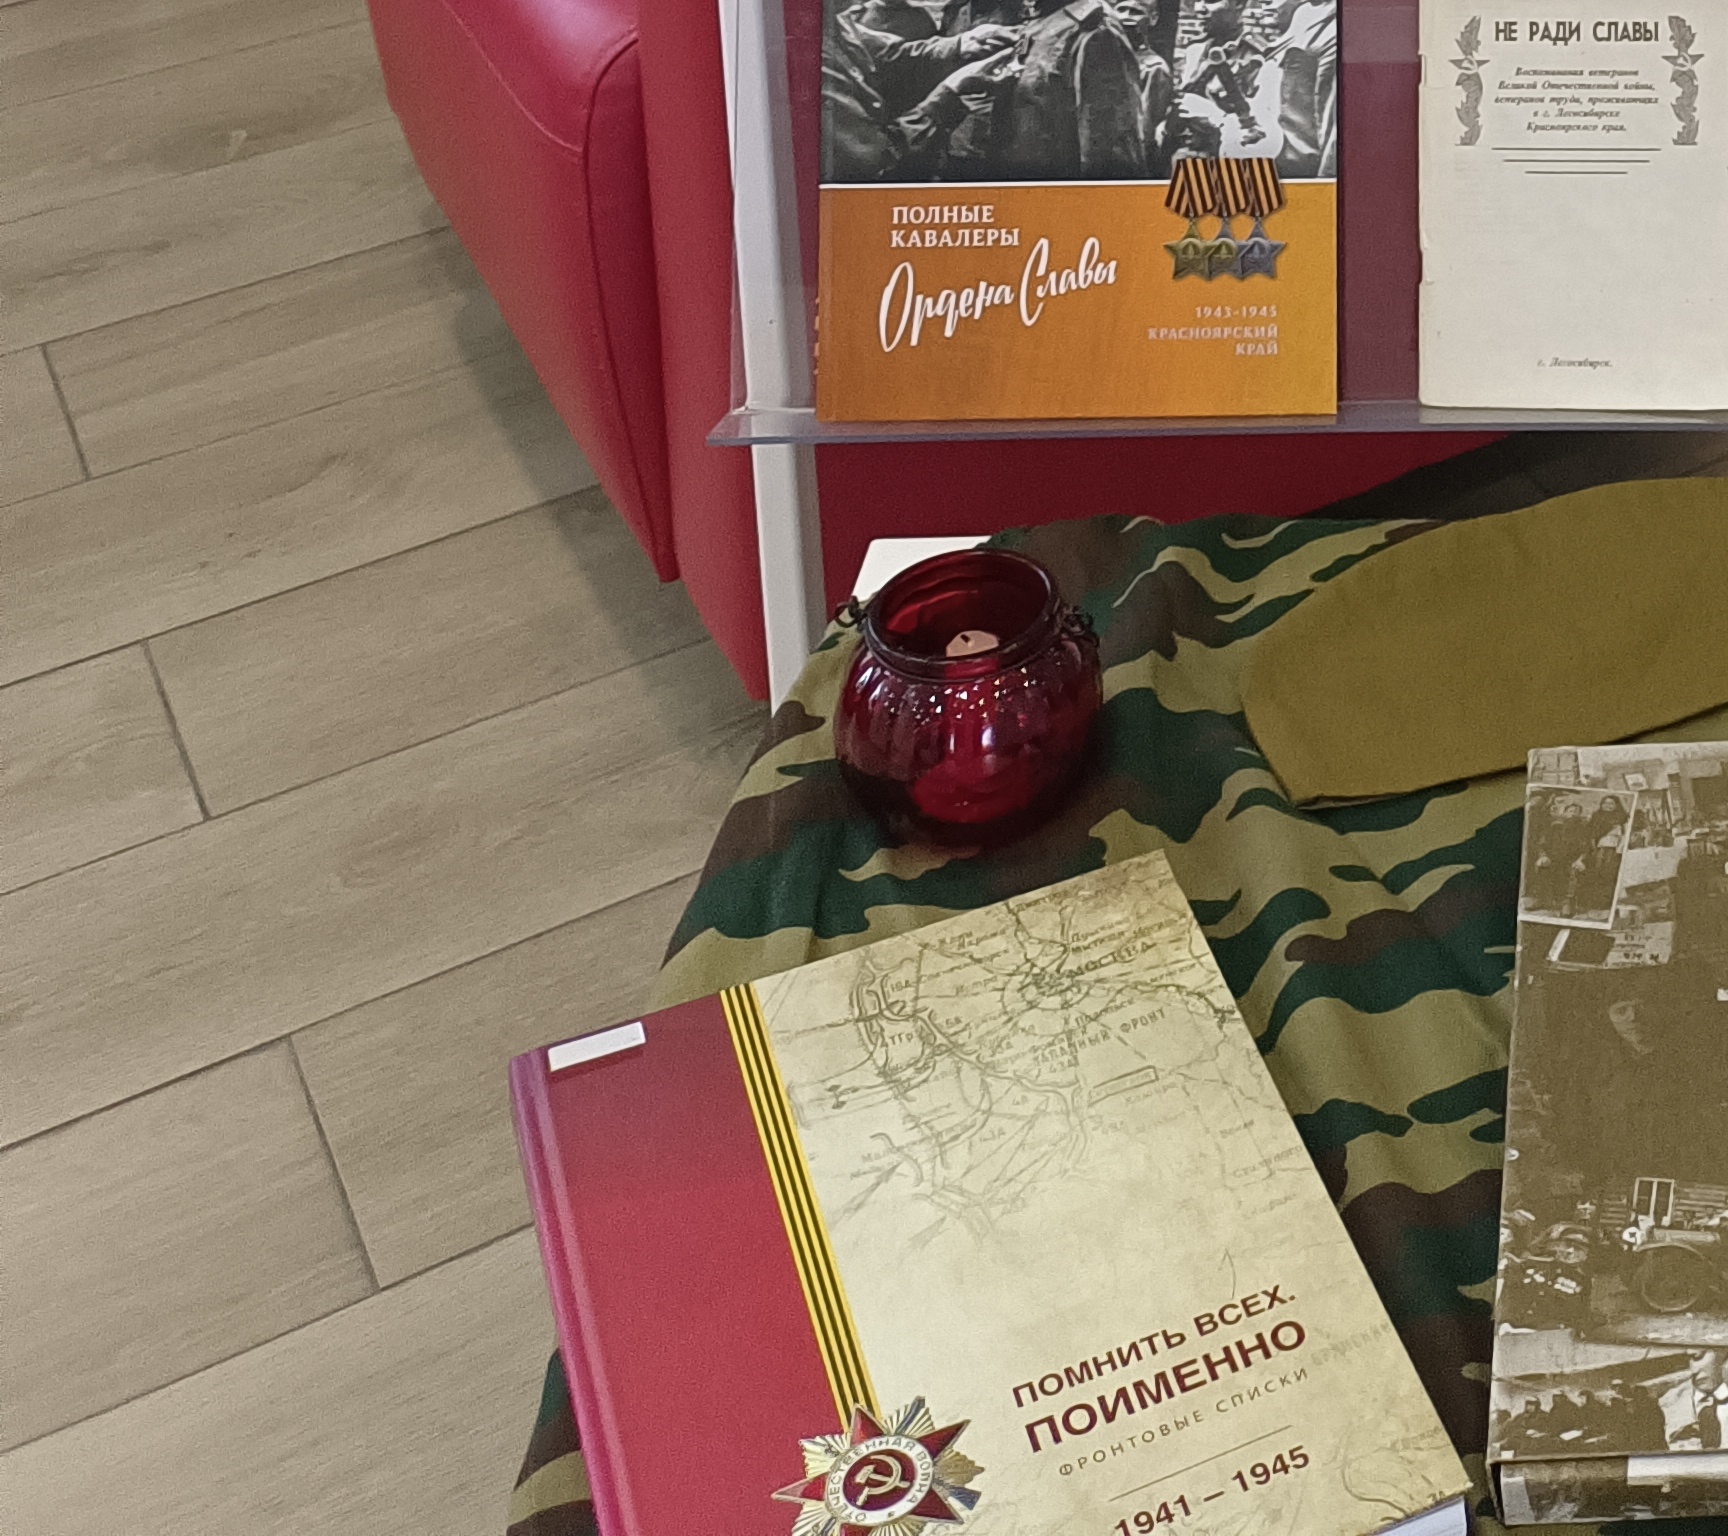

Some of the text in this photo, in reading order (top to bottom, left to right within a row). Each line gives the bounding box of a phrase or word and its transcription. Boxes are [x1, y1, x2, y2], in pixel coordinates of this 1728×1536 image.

[1494, 21, 1660, 47] НЕ РАДИ СЛАВЫ
[890, 227, 1020, 248] КАВАЛЕРЫ
[892, 205, 995, 225] ПОЛНЫЕ
[878, 237, 1118, 353] Ордена Славы
[1147, 323, 1279, 341] КРАСНОЯРСКИЙ
[1234, 339, 1279, 357] КРАЙ
[1012, 1284, 1297, 1408] ПОМНИТЬ ВСЕХ.
[1024, 1320, 1307, 1454] ПОИМЕННО
[1058, 1367, 1310, 1477] ФРОНТОВЫЕ СПИСКИ
[1113, 1444, 1311, 1536] 1941 1945
